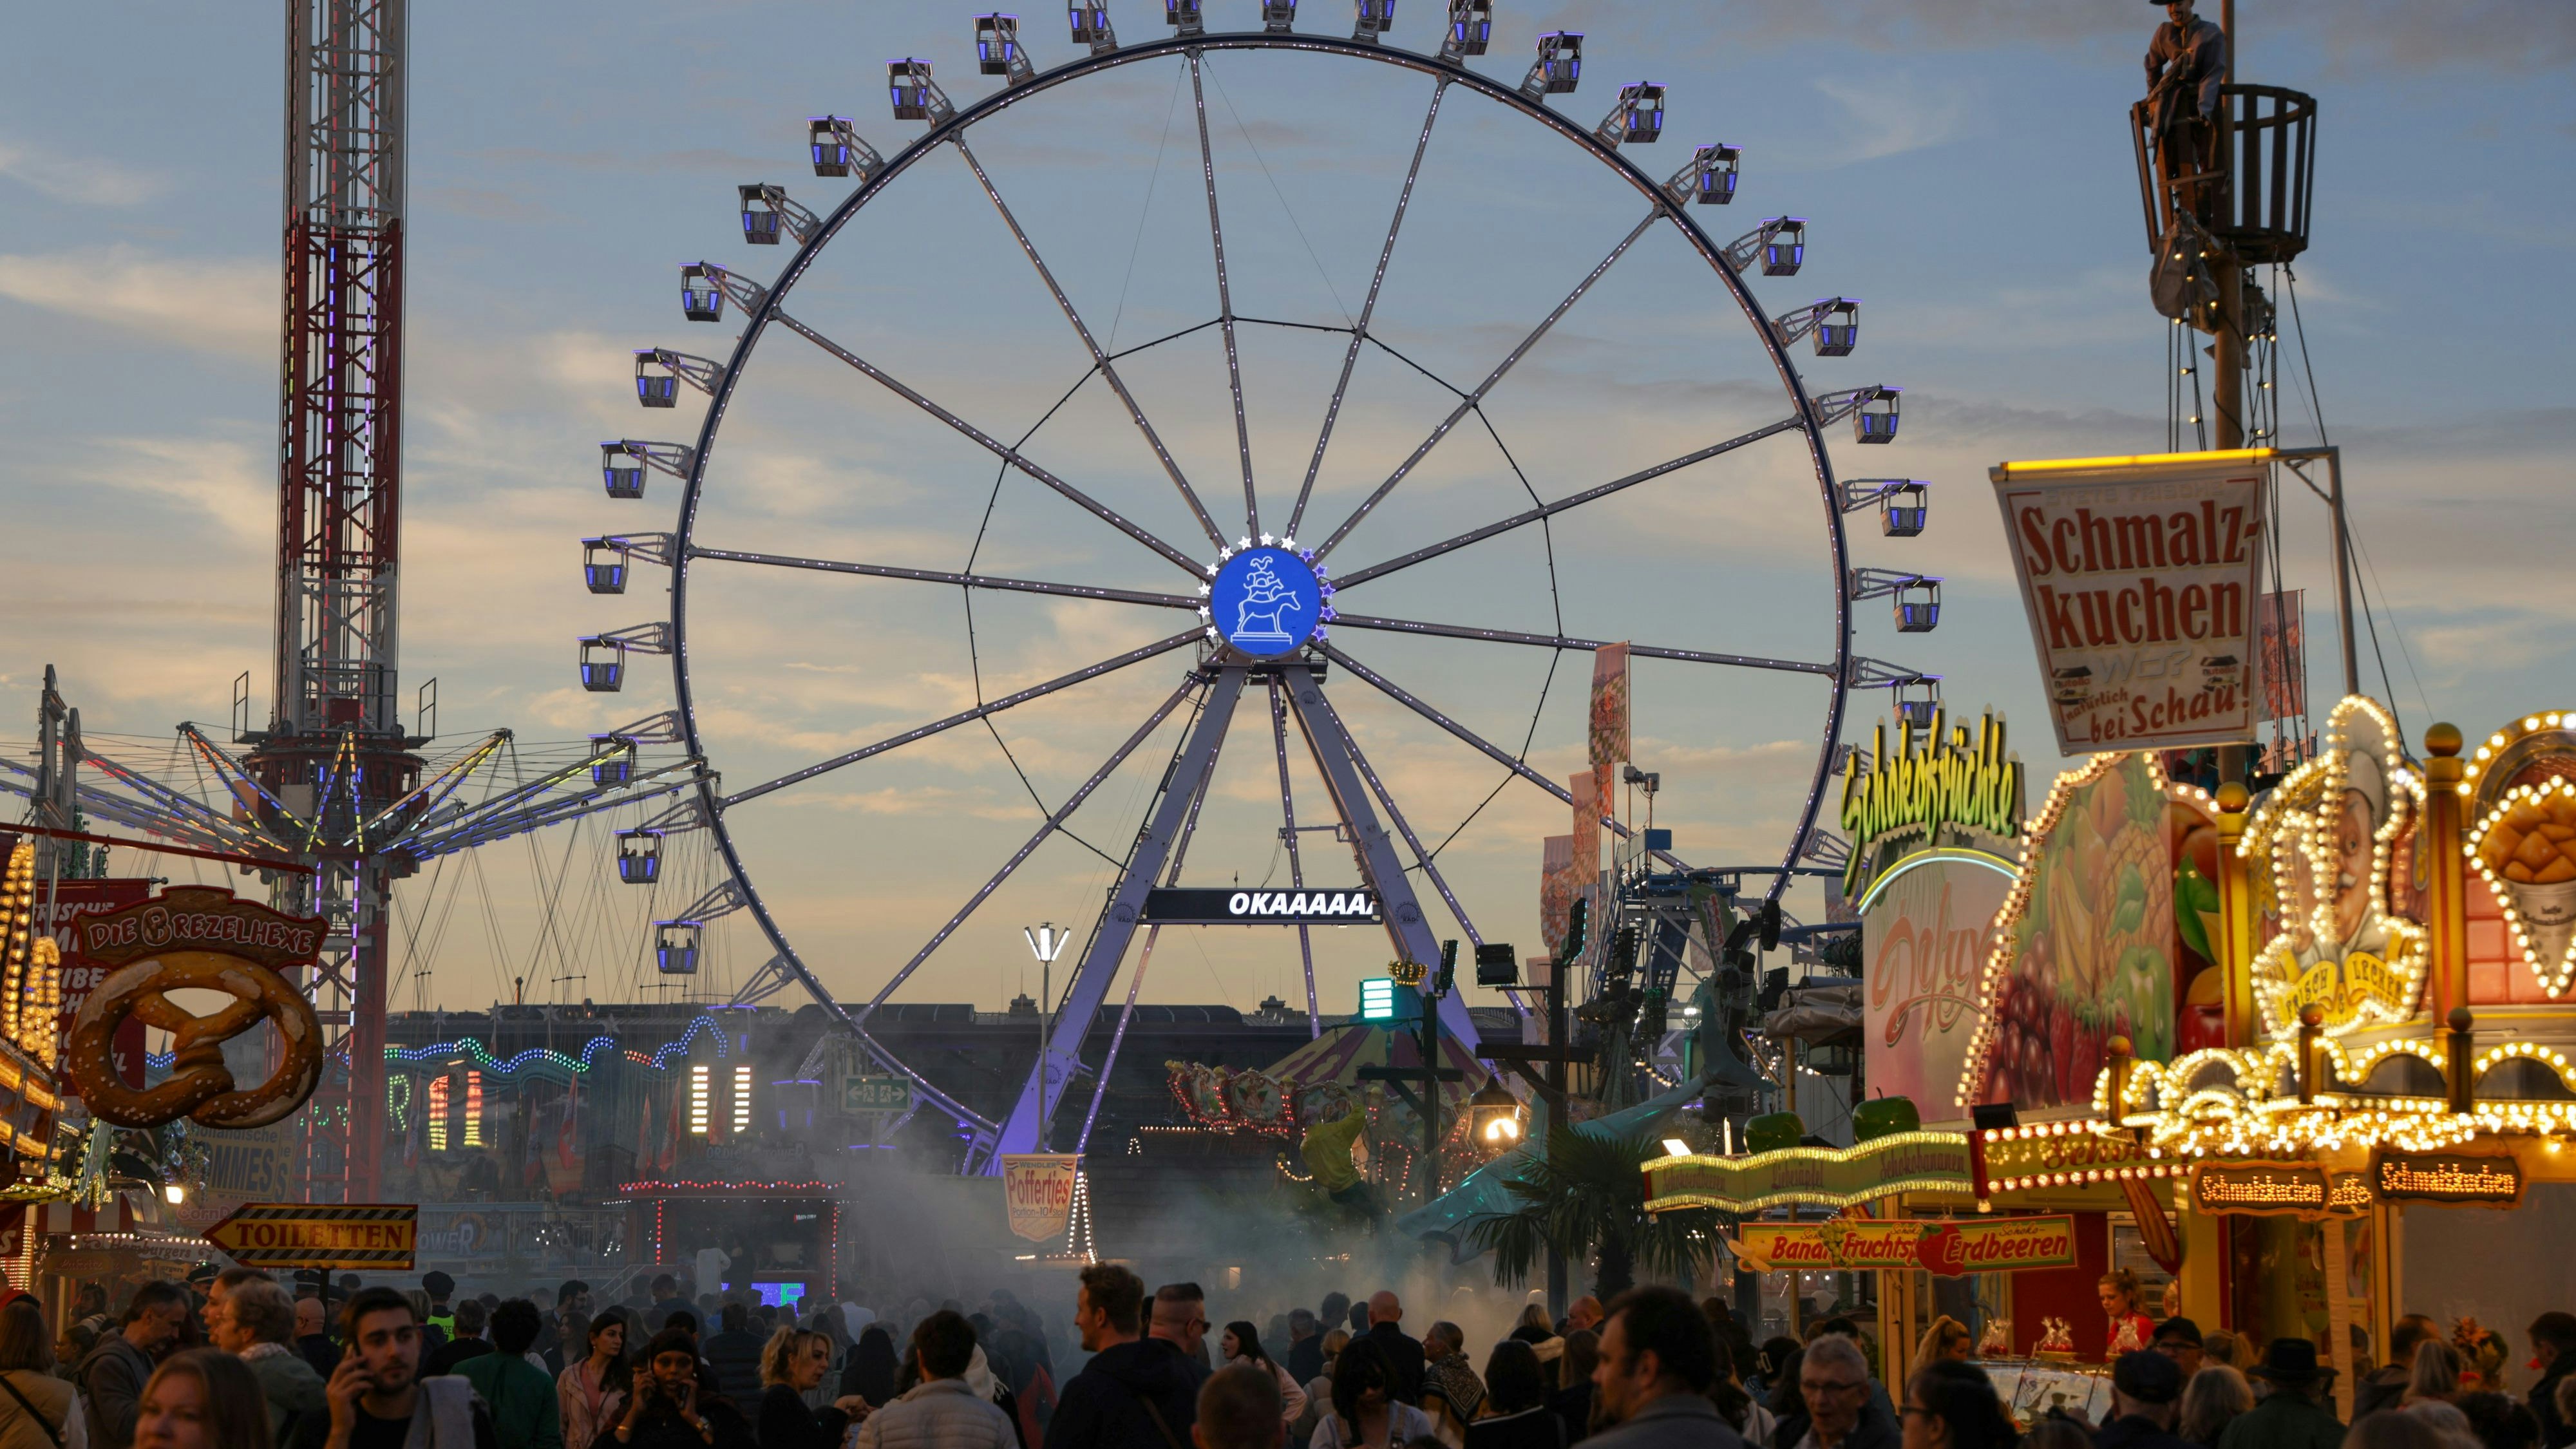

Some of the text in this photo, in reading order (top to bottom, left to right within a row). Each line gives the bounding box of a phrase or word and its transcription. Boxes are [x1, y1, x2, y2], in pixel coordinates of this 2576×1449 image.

[2020, 500, 2260, 576] Schmalz-
[2038, 578, 2243, 649] kuchen
[2066, 687, 2128, 721] natürlich
[2090, 707, 2126, 743] bei
[2130, 665, 2251, 734] Schau!
[1841, 708, 2015, 897] Schokofrüchte
[88, 918, 137, 951] DIE
[141, 905, 315, 954] BREZELHEXE
[1871, 882, 2000, 1045] Delux
[1007, 1170, 1070, 1213] Poffertjes
[2202, 1174, 2322, 1202] Schmalzkuchen
[2382, 1162, 2516, 1195] Schmalzkuchen
[236, 1223, 404, 1249] TOILETTEN
[1944, 1231, 2069, 1265] Erdbeeren
